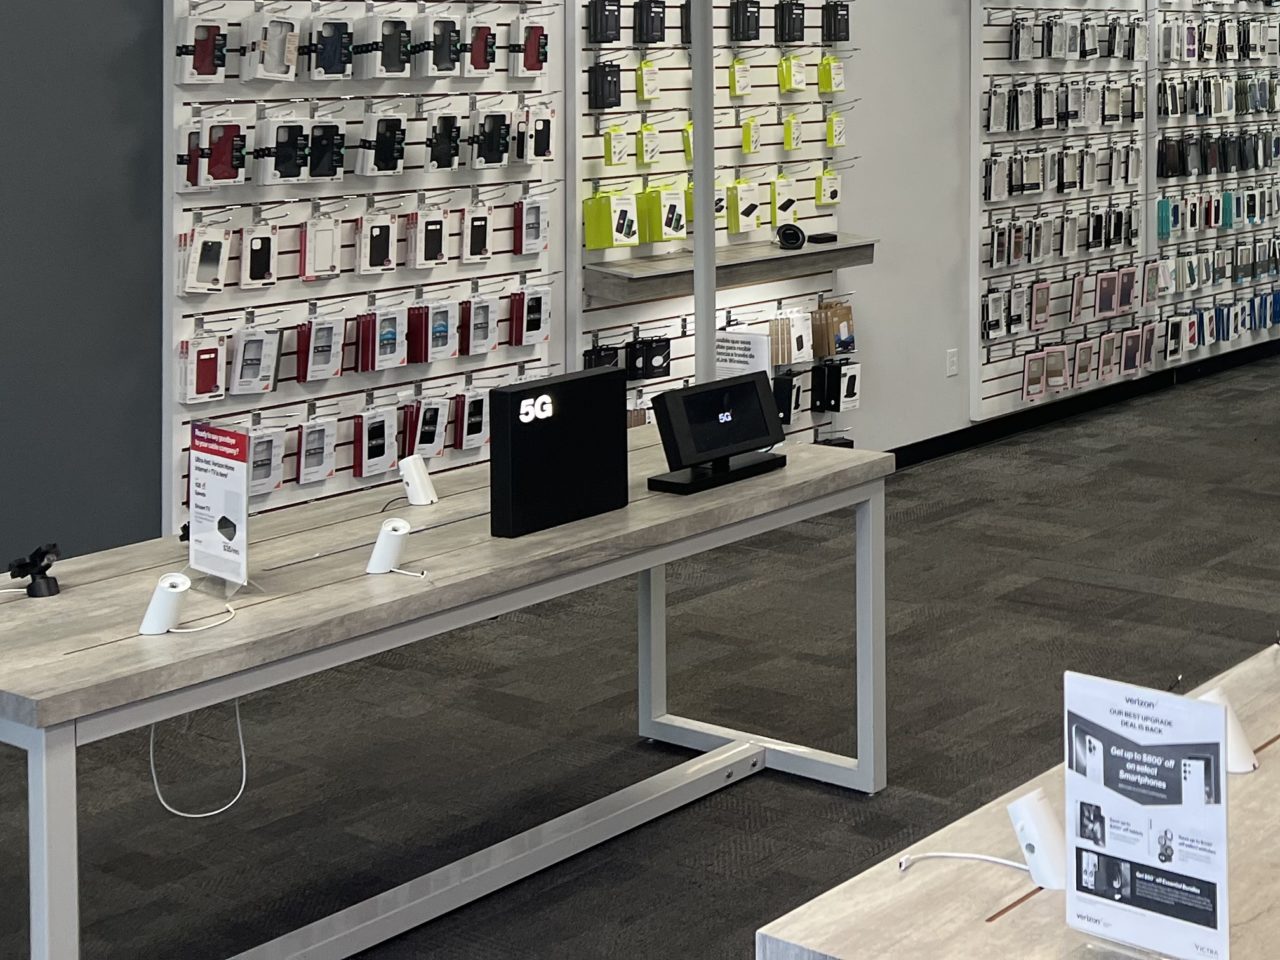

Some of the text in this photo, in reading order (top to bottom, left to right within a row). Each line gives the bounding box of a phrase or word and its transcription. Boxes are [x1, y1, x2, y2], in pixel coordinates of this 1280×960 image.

[519, 394, 553, 423] 5G
[718, 411, 732, 423] 5G
[1125, 696, 1155, 709] verizon
[1109, 708, 1173, 727] OUR BEST UPGRADE
[1120, 720, 1136, 729] DEAL
[1145, 726, 1163, 734] BACK
[1110, 745, 1123, 757] Get
[1124, 750, 1133, 760] up
[1134, 751, 1141, 761] to
[1164, 759, 1175, 769] off
[1126, 762, 1158, 776] on select
[1119, 769, 1167, 790] Smartphones
[1077, 913, 1101, 925] verizon
